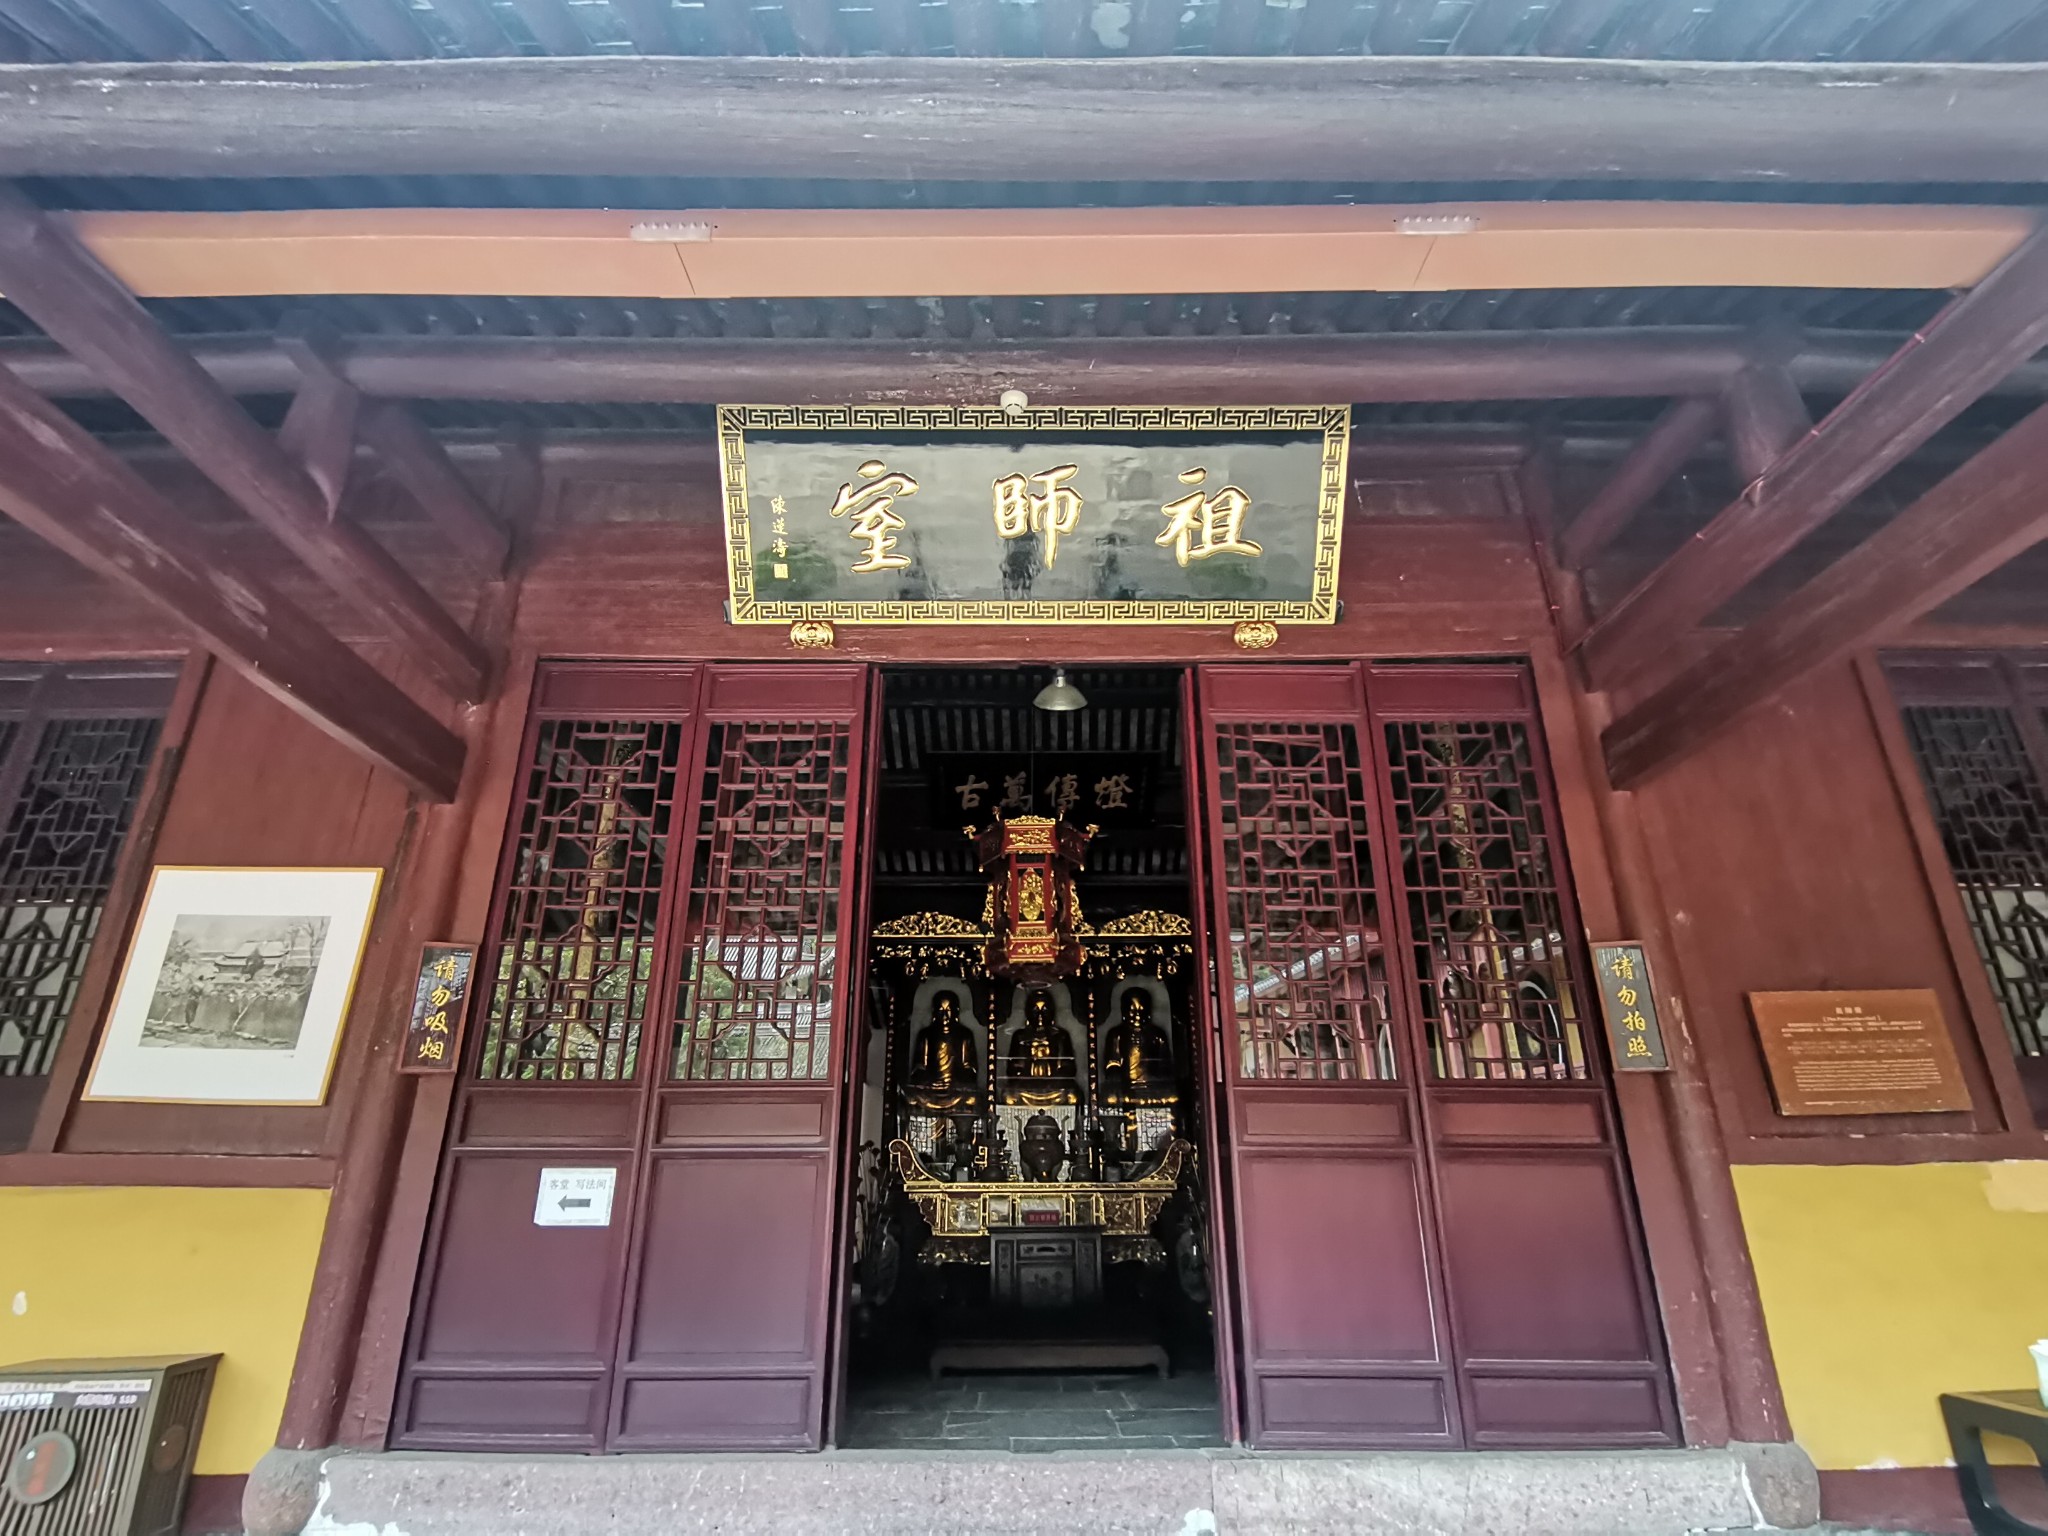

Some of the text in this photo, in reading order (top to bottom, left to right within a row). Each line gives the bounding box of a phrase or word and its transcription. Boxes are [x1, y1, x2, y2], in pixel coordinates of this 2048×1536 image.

[831, 460, 1262, 574] 祖師室
[417, 955, 459, 1060] 请勿吸烟
[1610, 955, 1653, 1058] 请勿拍照
